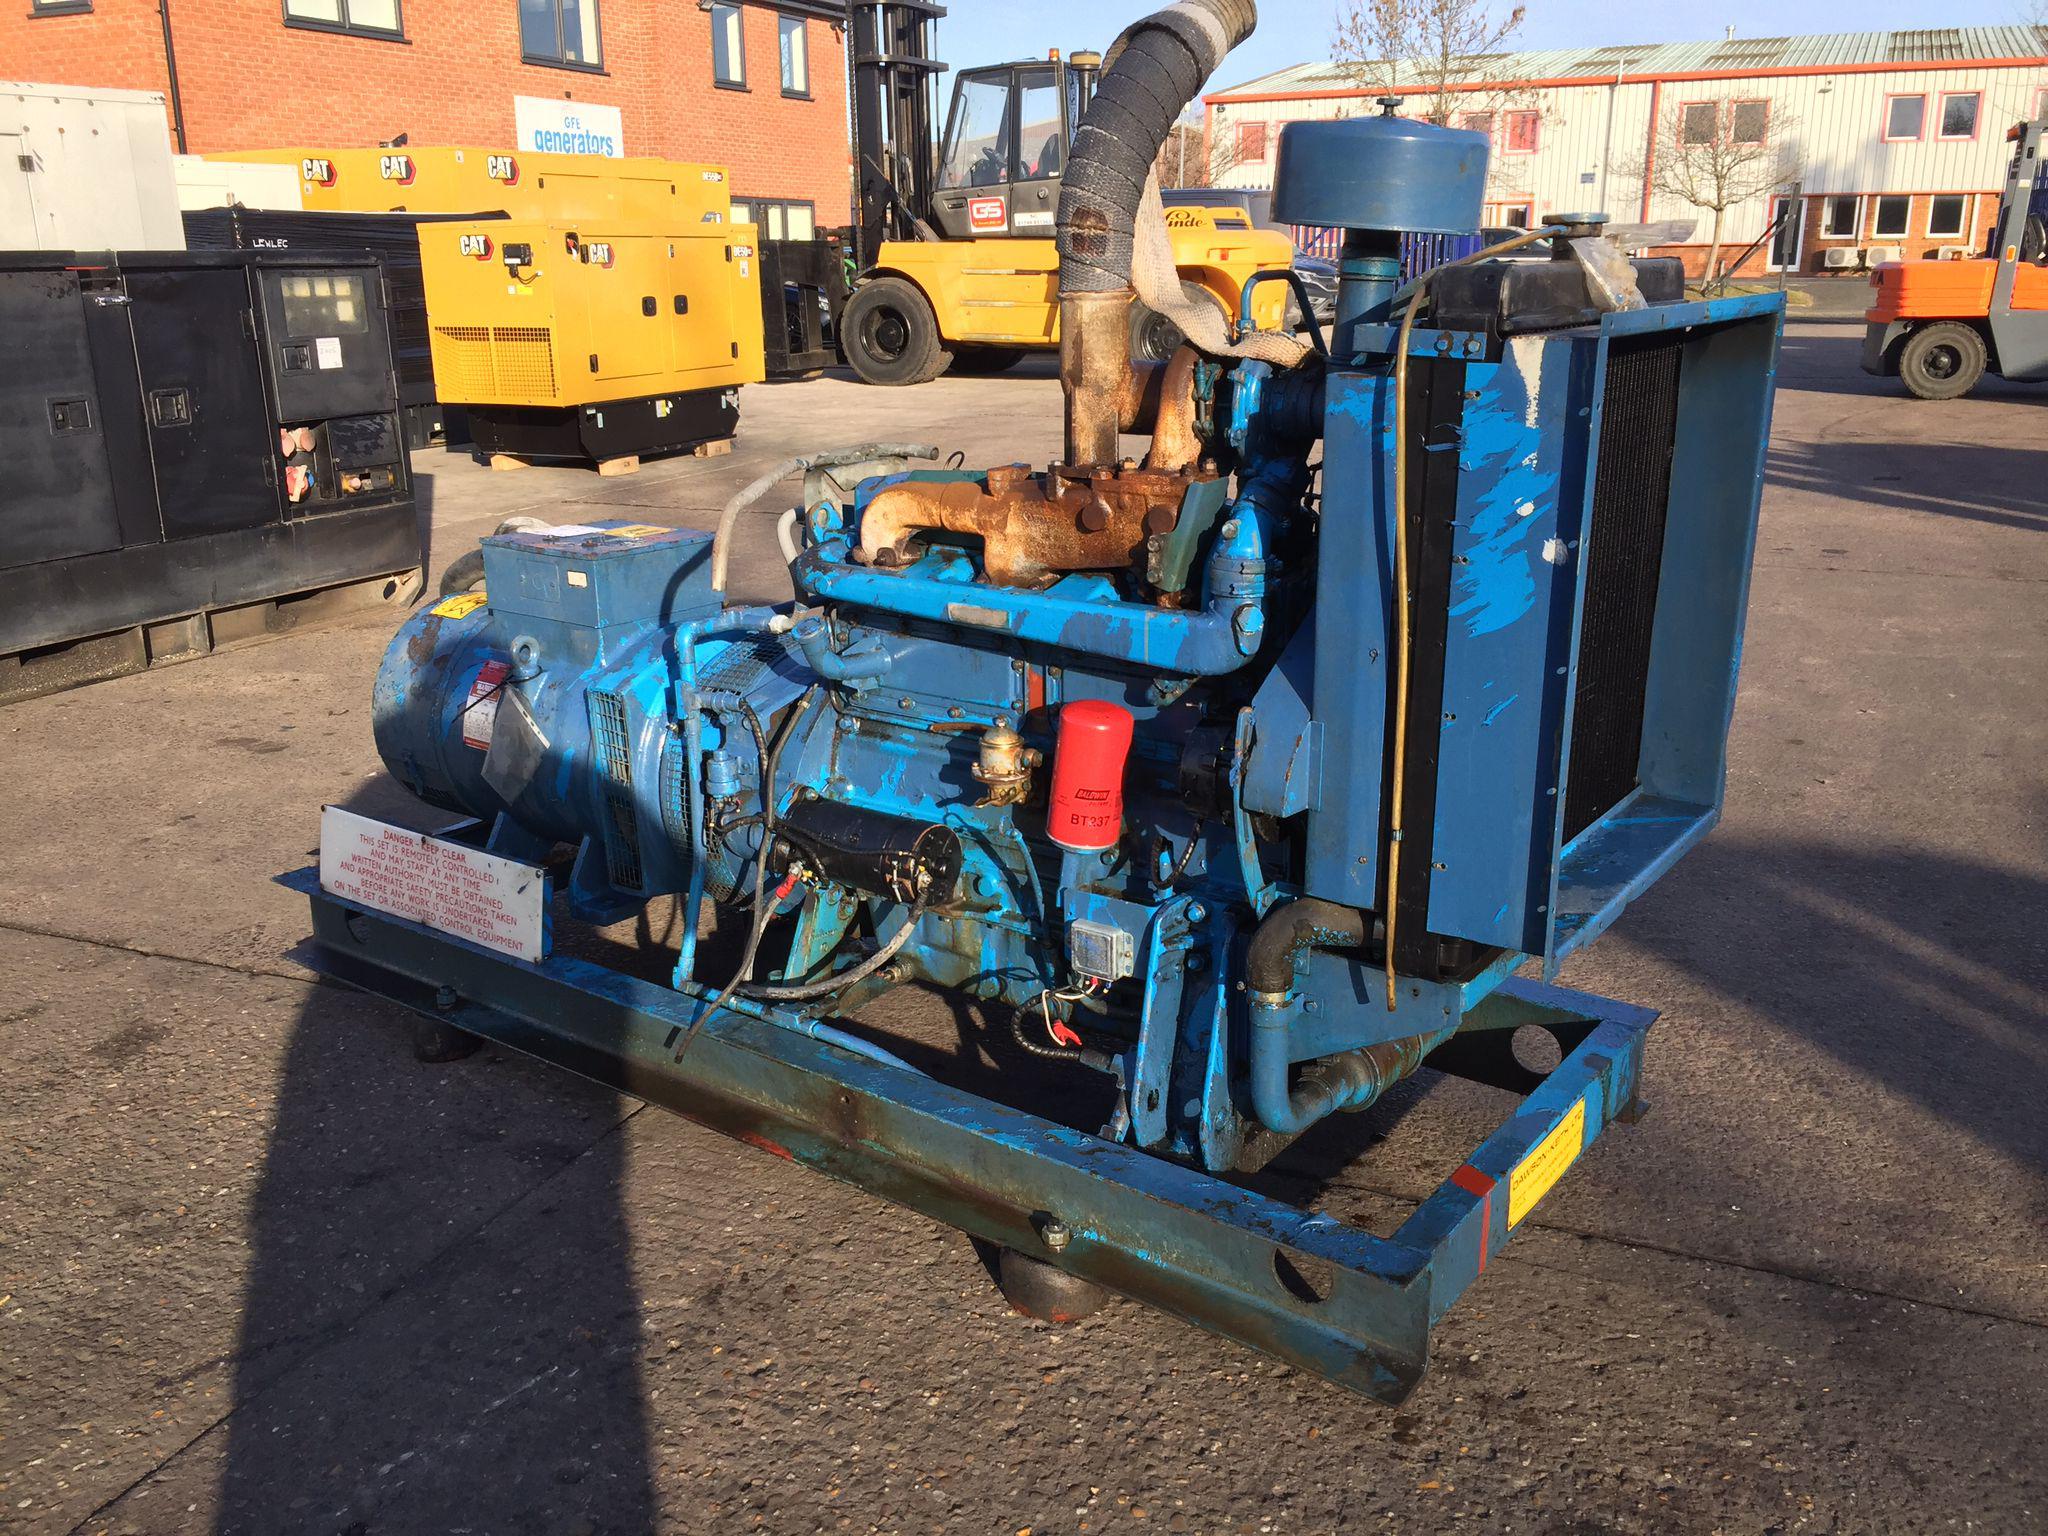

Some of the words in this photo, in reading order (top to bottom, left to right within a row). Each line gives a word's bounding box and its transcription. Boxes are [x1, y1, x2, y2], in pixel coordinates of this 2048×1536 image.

[564, 116, 581, 130] GFE
[534, 129, 614, 157] generators
[302, 159, 329, 180] CAT
[380, 156, 408, 179] CAT
[487, 155, 513, 180] CAT
[460, 235, 486, 256] CAT
[590, 243, 609, 264] CAT
[359, 833, 374, 846] THIS
[376, 838, 388, 851] SET
[392, 843, 397, 854] IS
[401, 846, 438, 866] REMOTELY
[442, 858, 494, 883] CONTROLLED
[384, 830, 413, 847] DANGER
[421, 841, 438, 855] KEEP
[442, 847, 466, 863] CLEAR
[351, 853, 380, 871] WRITTEN
[384, 863, 424, 885] AUTHORITY
[428, 877, 447, 892] MUST
[451, 884, 460, 896] BE
[463, 888, 503, 910] OBTAINED
[370, 848, 385, 860] AND
[389, 854, 404, 866] MAY
[407, 859, 428, 874] START
[432, 867, 440, 878] AT
[445, 871, 459, 884] ANY
[463, 877, 482, 891] TIME
[340, 860, 354, 873] AND
[357, 866, 403, 889] APPROPRIATE
[406, 881, 432, 898] SAFETY
[435, 891, 487, 916] PRECAUTIONS
[490, 908, 516, 925] TAKEN
[361, 878, 387, 894] BEFORE
[390, 887, 405, 900] ANY
[409, 893, 429, 908] WORK
[433, 901, 439, 911] IS
[442, 904, 492, 929] UNDERTAKEN
[334, 879, 344, 891] ON
[347, 884, 360, 897] THE
[363, 889, 375, 901] SET
[378, 894, 388, 906] OR
[392, 898, 436, 922] ASSOCIATED
[439, 914, 473, 935] CONTROL
[478, 927, 523, 951] EQUIPMENT
